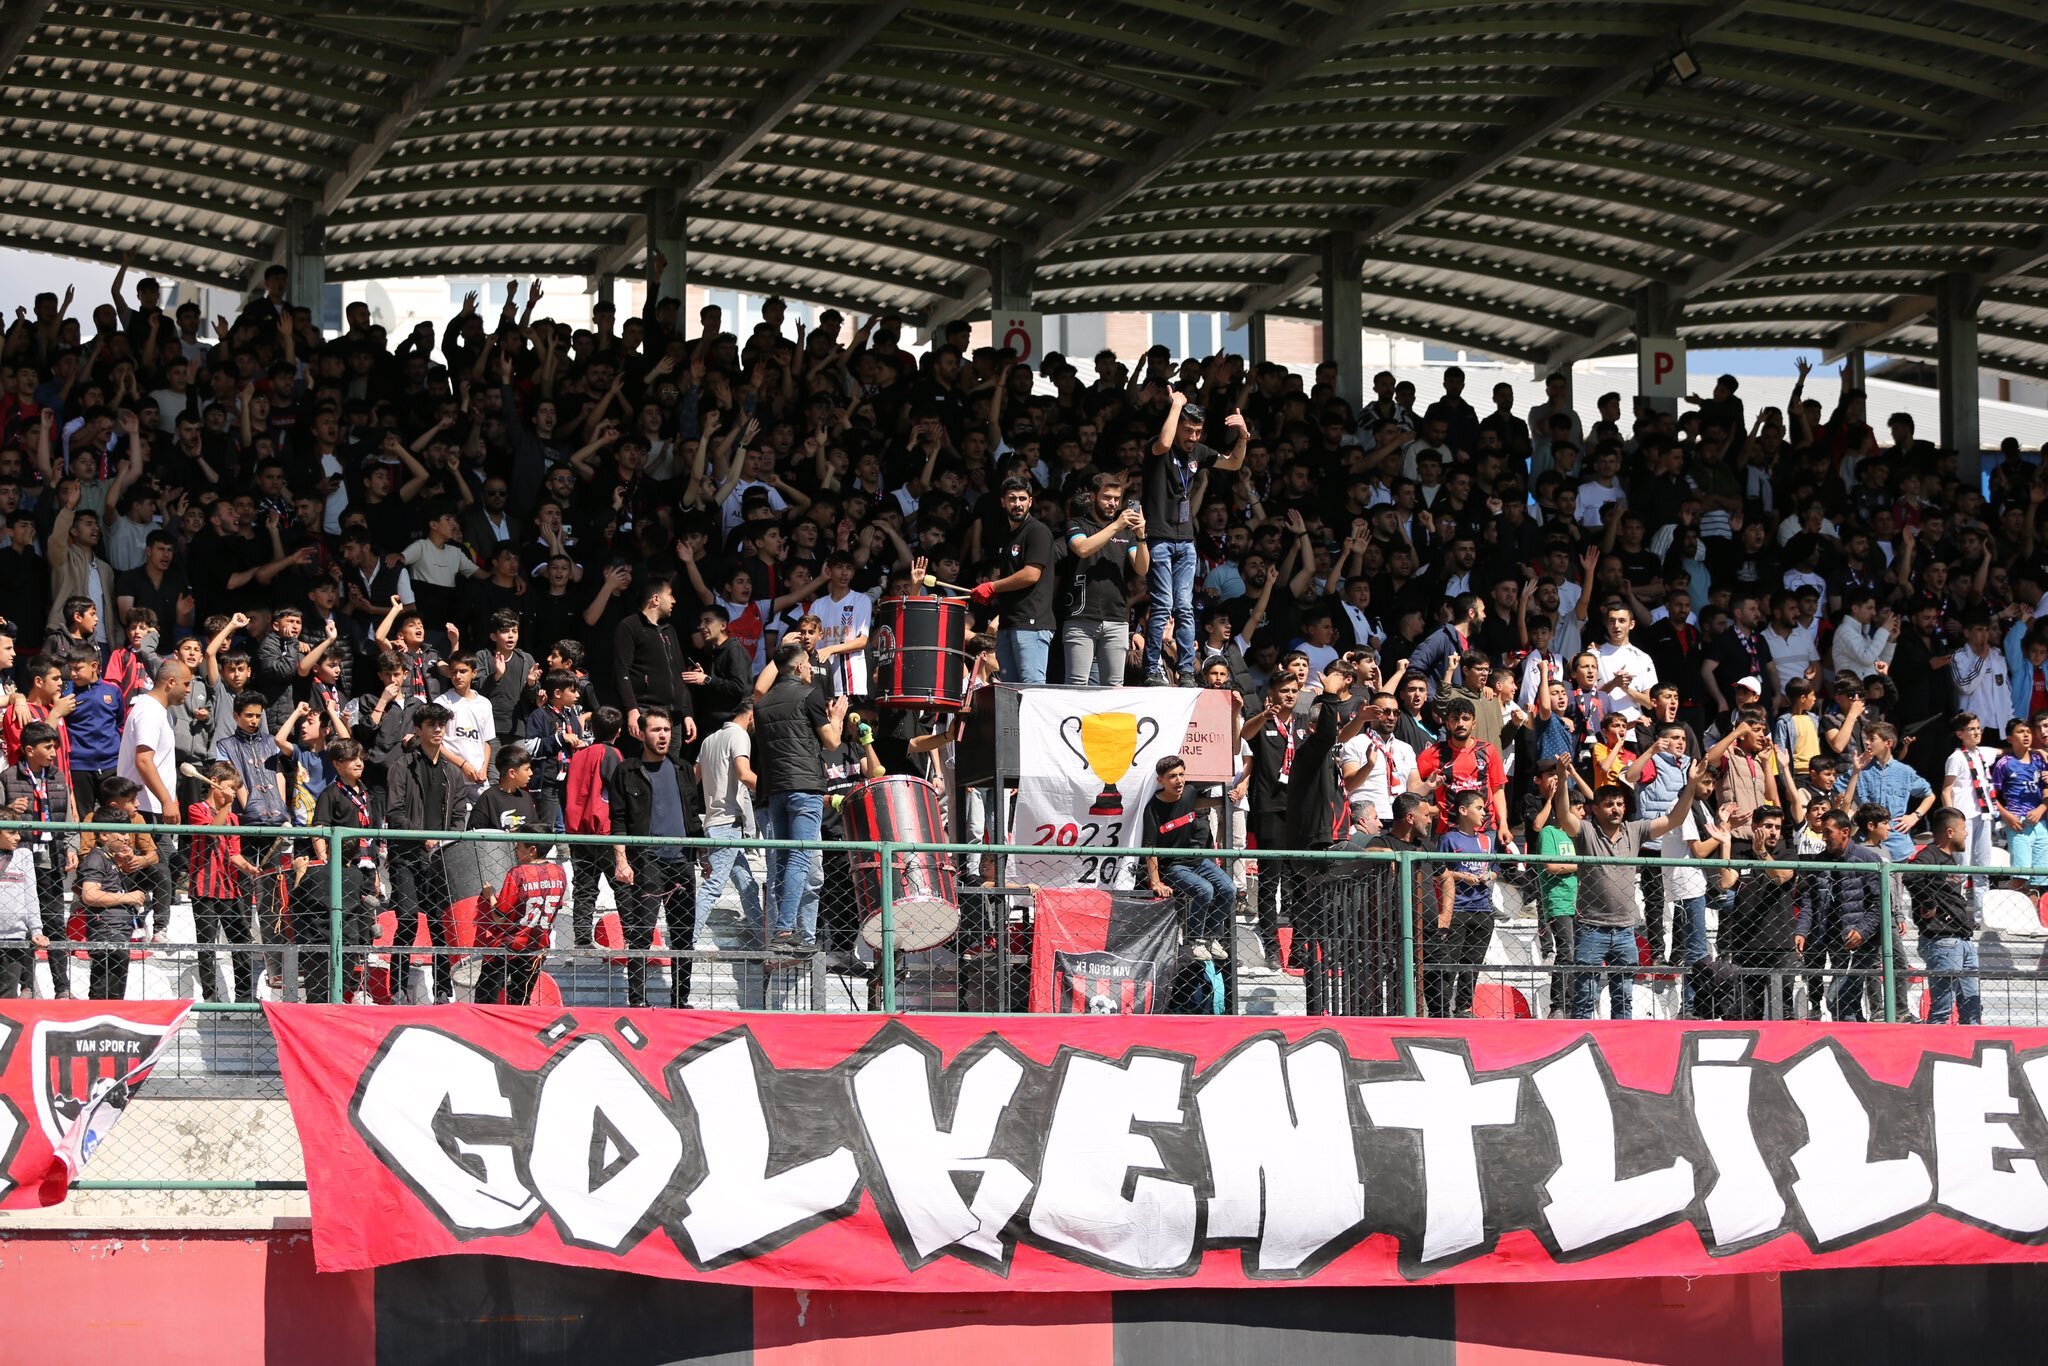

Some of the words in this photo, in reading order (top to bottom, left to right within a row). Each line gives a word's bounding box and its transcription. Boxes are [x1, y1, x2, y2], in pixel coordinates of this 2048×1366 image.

[1003, 319, 1031, 363] Ö
[1654, 351, 1674, 385] P
[1032, 822, 1122, 848] 2023
[522, 881, 539, 892] VAN
[519, 895, 561, 929] 65
[76, 1039, 97, 1053] VAN
[99, 1039, 126, 1053] SPOR
[127, 1040, 141, 1054] FK
[350, 1017, 2048, 1277] GÖLKENTLİLE
